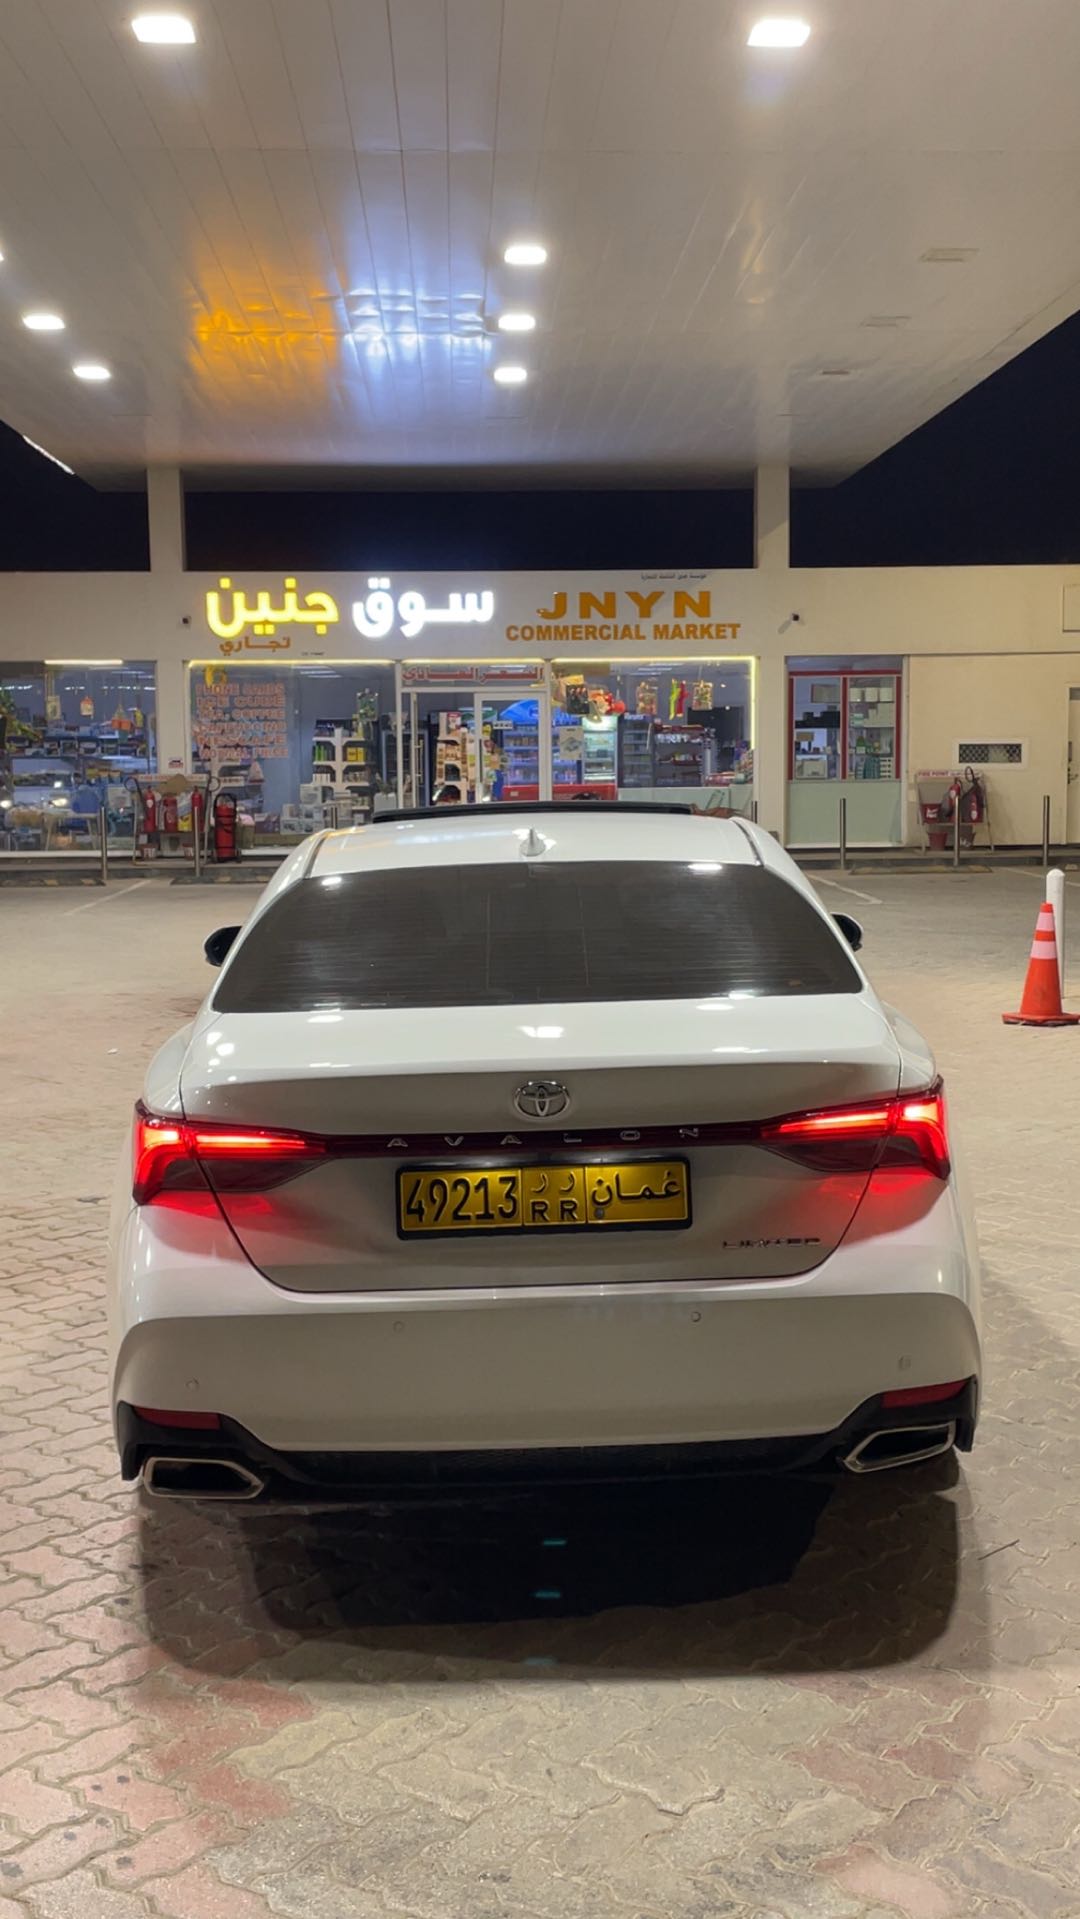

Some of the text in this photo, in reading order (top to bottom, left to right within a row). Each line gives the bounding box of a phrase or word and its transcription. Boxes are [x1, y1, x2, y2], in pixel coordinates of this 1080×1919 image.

[206, 577, 495, 638] سوق جنين
[536, 591, 711, 620] JNYN
[506, 623, 742, 641] COMMERCIAL MARKET
[219, 636, 291, 657] تجاري
[387, 1127, 699, 1148] AVALON
[406, 1175, 518, 1223] 49213
